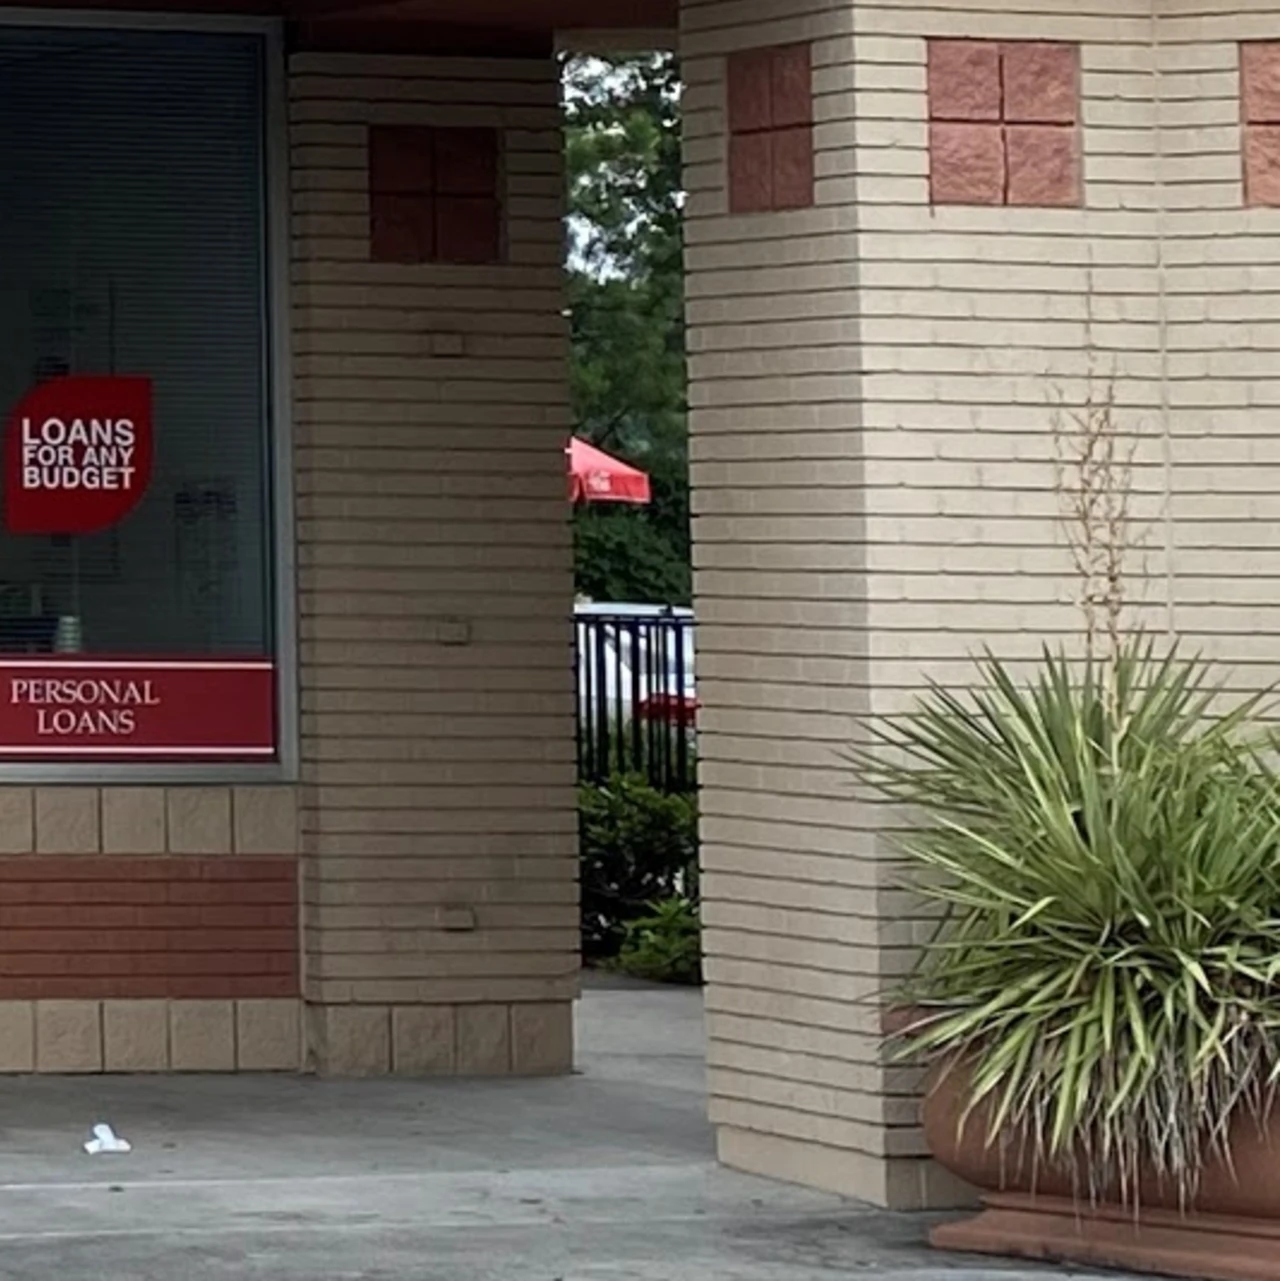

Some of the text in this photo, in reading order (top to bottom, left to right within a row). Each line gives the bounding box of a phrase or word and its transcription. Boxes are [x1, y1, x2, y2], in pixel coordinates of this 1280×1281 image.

[21, 417, 136, 446] LOANS
[22, 445, 135, 466] FOR ANY
[22, 466, 136, 490] BUDGET
[10, 678, 161, 705] PERSONAL
[36, 709, 137, 736] LOANS
